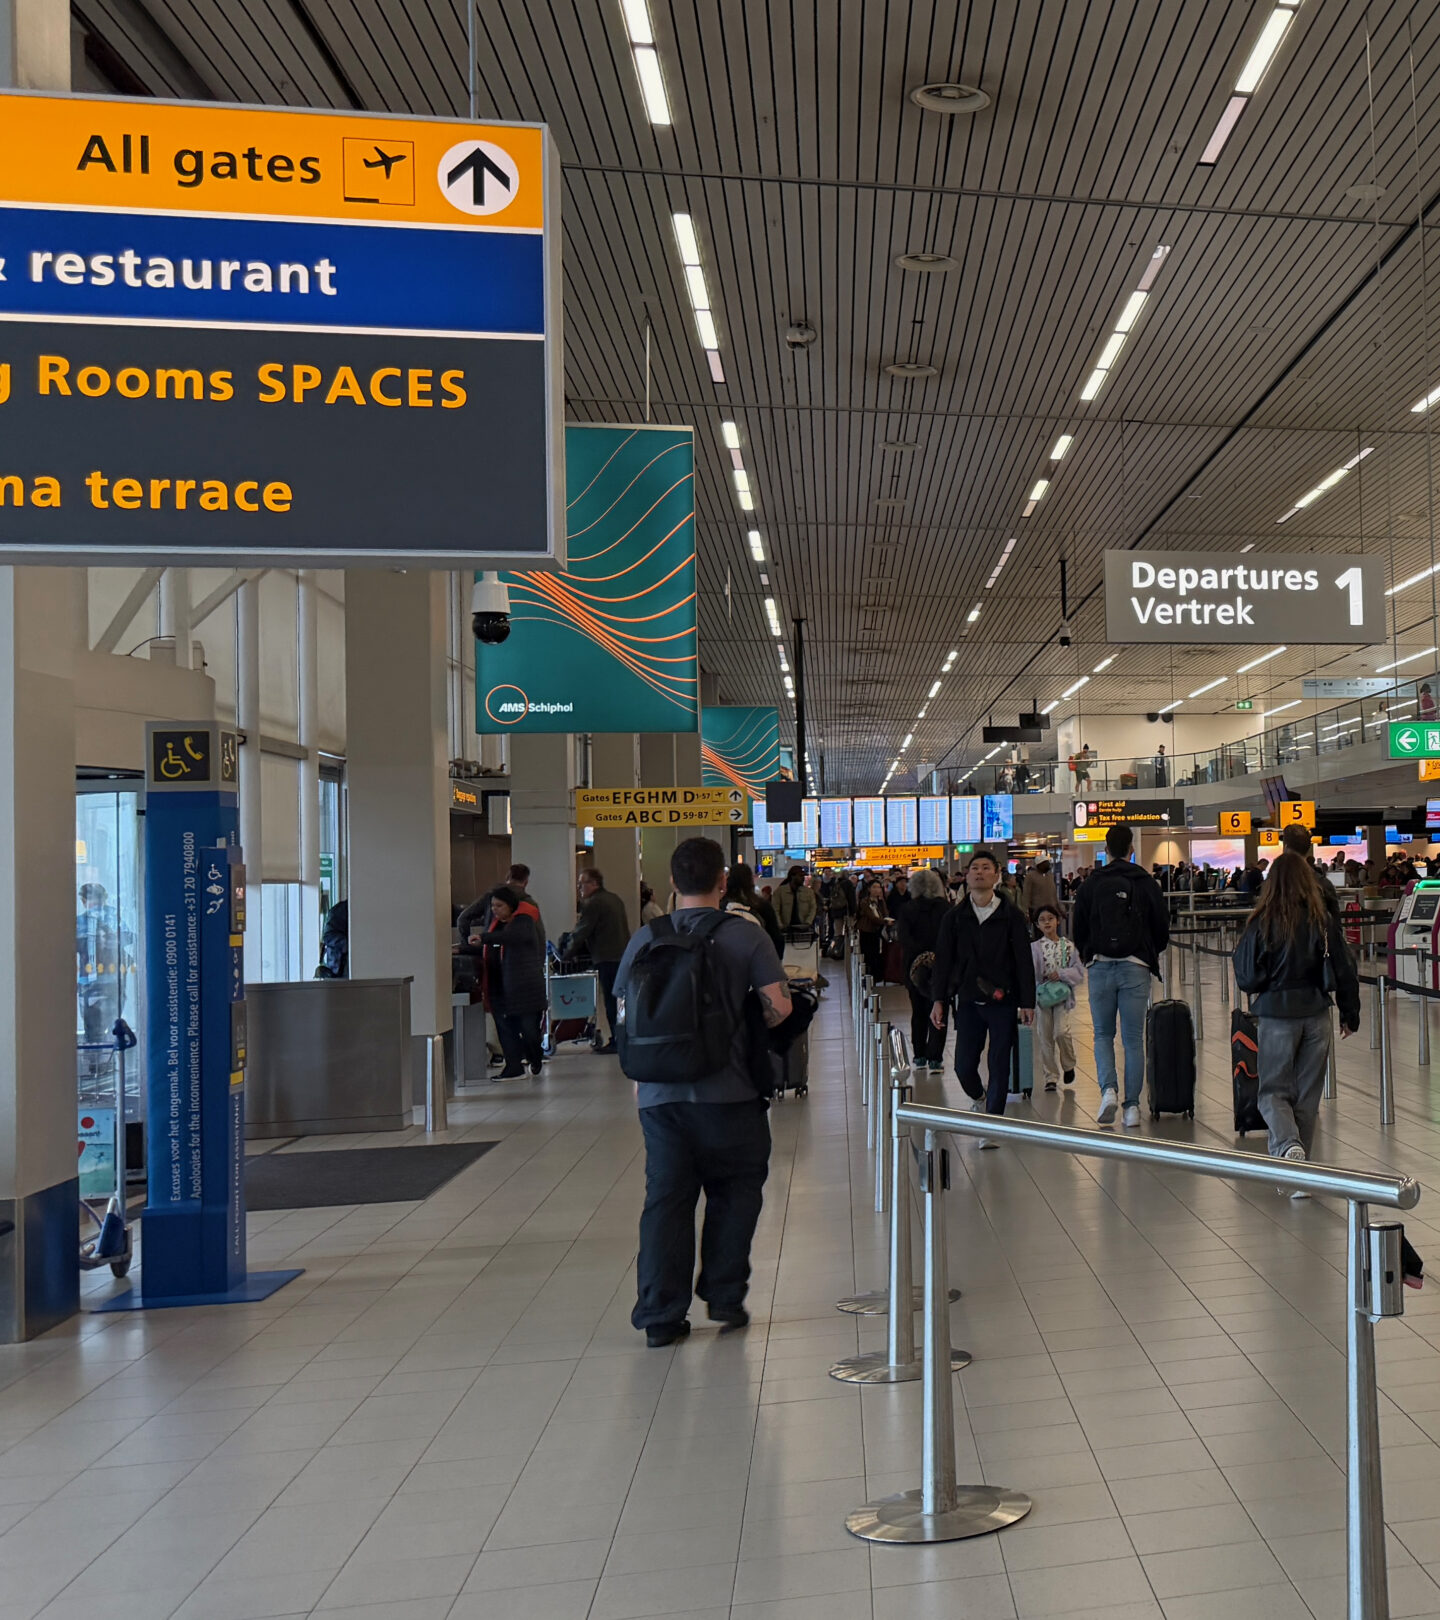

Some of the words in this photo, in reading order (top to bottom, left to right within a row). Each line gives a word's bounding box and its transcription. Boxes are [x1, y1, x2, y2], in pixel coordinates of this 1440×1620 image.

[77, 134, 150, 174] All
[173, 145, 322, 188] gates
[30, 248, 338, 295] restaurant
[38, 354, 234, 402] Rooms
[257, 363, 468, 409] SPACES
[86, 471, 294, 512] terrace
[1131, 562, 1319, 596] Departures
[1334, 567, 1364, 626] 1
[1131, 597, 1255, 626] Vertrek
[498, 702, 526, 713] AMS
[528, 702, 573, 714] Schiphol
[583, 794, 610, 802] Gates
[596, 813, 622, 821] Gates
[1230, 813, 1240, 828] 6
[1292, 804, 1303, 820] 5
[1266, 833, 1272, 841] 8
[183, 831, 195, 875] 7940800
[184, 877, 195, 890] 20
[184, 892, 196, 911] +31
[165, 914, 176, 938] 0141
[186, 912, 198, 967] assistance:
[166, 941, 177, 964] 0900
[186, 968, 198, 983] for
[167, 966, 179, 1022] assistentie:
[186, 985, 198, 1001] call
[187, 1004, 199, 1036] Please
[169, 1025, 179, 1047] voor
[168, 1050, 179, 1065] Bel
[188, 1038, 200, 1112] inconvenience.
[168, 1067, 182, 1118] ongemak.
[168, 1120, 179, 1137] het
[188, 1113, 200, 1130] the
[170, 1139, 180, 1160] voor
[188, 1132, 200, 1147] for
[170, 1164, 182, 1201] Excuses
